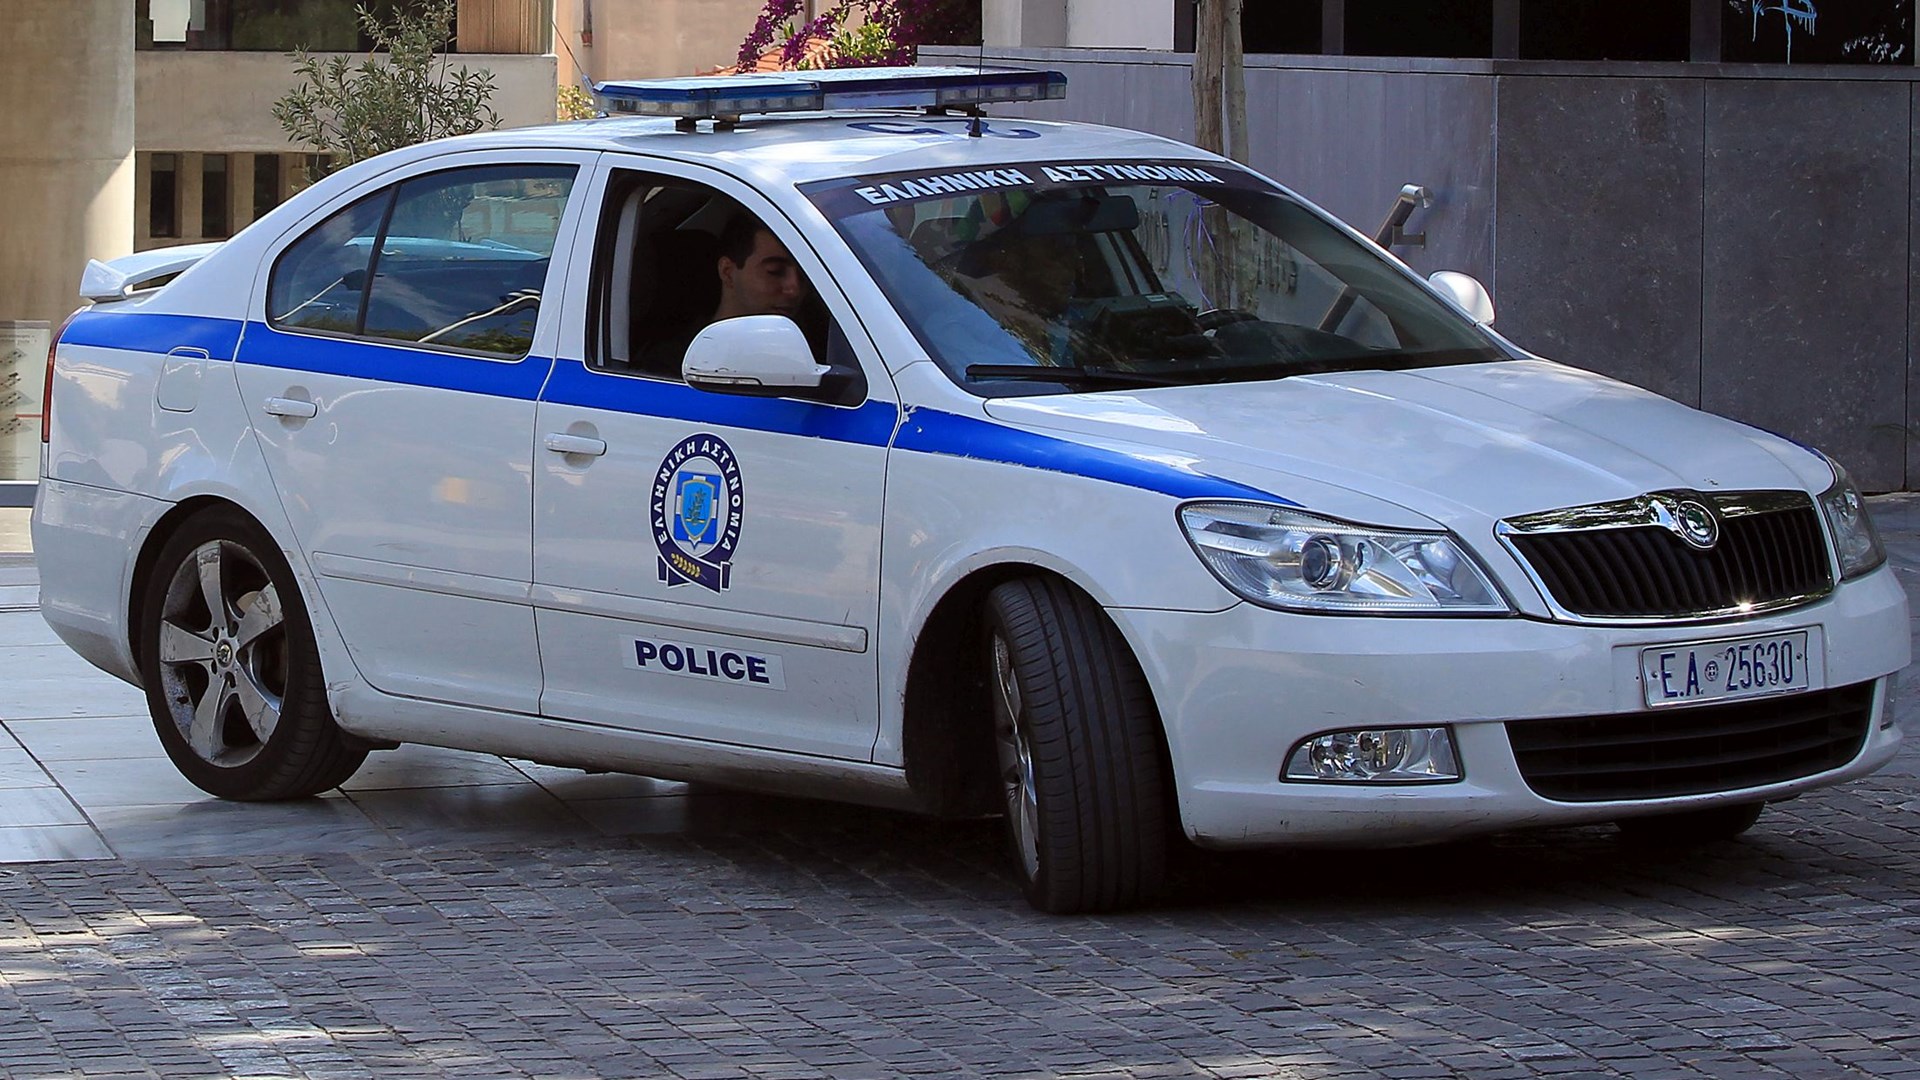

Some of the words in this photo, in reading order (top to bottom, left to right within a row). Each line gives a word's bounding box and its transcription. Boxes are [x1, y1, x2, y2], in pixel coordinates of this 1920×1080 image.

[854, 168, 1034, 205] ΕΛΛΗΝΙΚΗ
[1041, 164, 1225, 184] ΑΣΤΥΝΟΜΙΑ
[653, 441, 696, 545] ΕΛΛΗΝΙΚΗ
[701, 440, 741, 551] ΑΣΤΥΝΟΜΙΑ
[634, 640, 770, 684] POLICE
[1724, 640, 1793, 692] 25630
